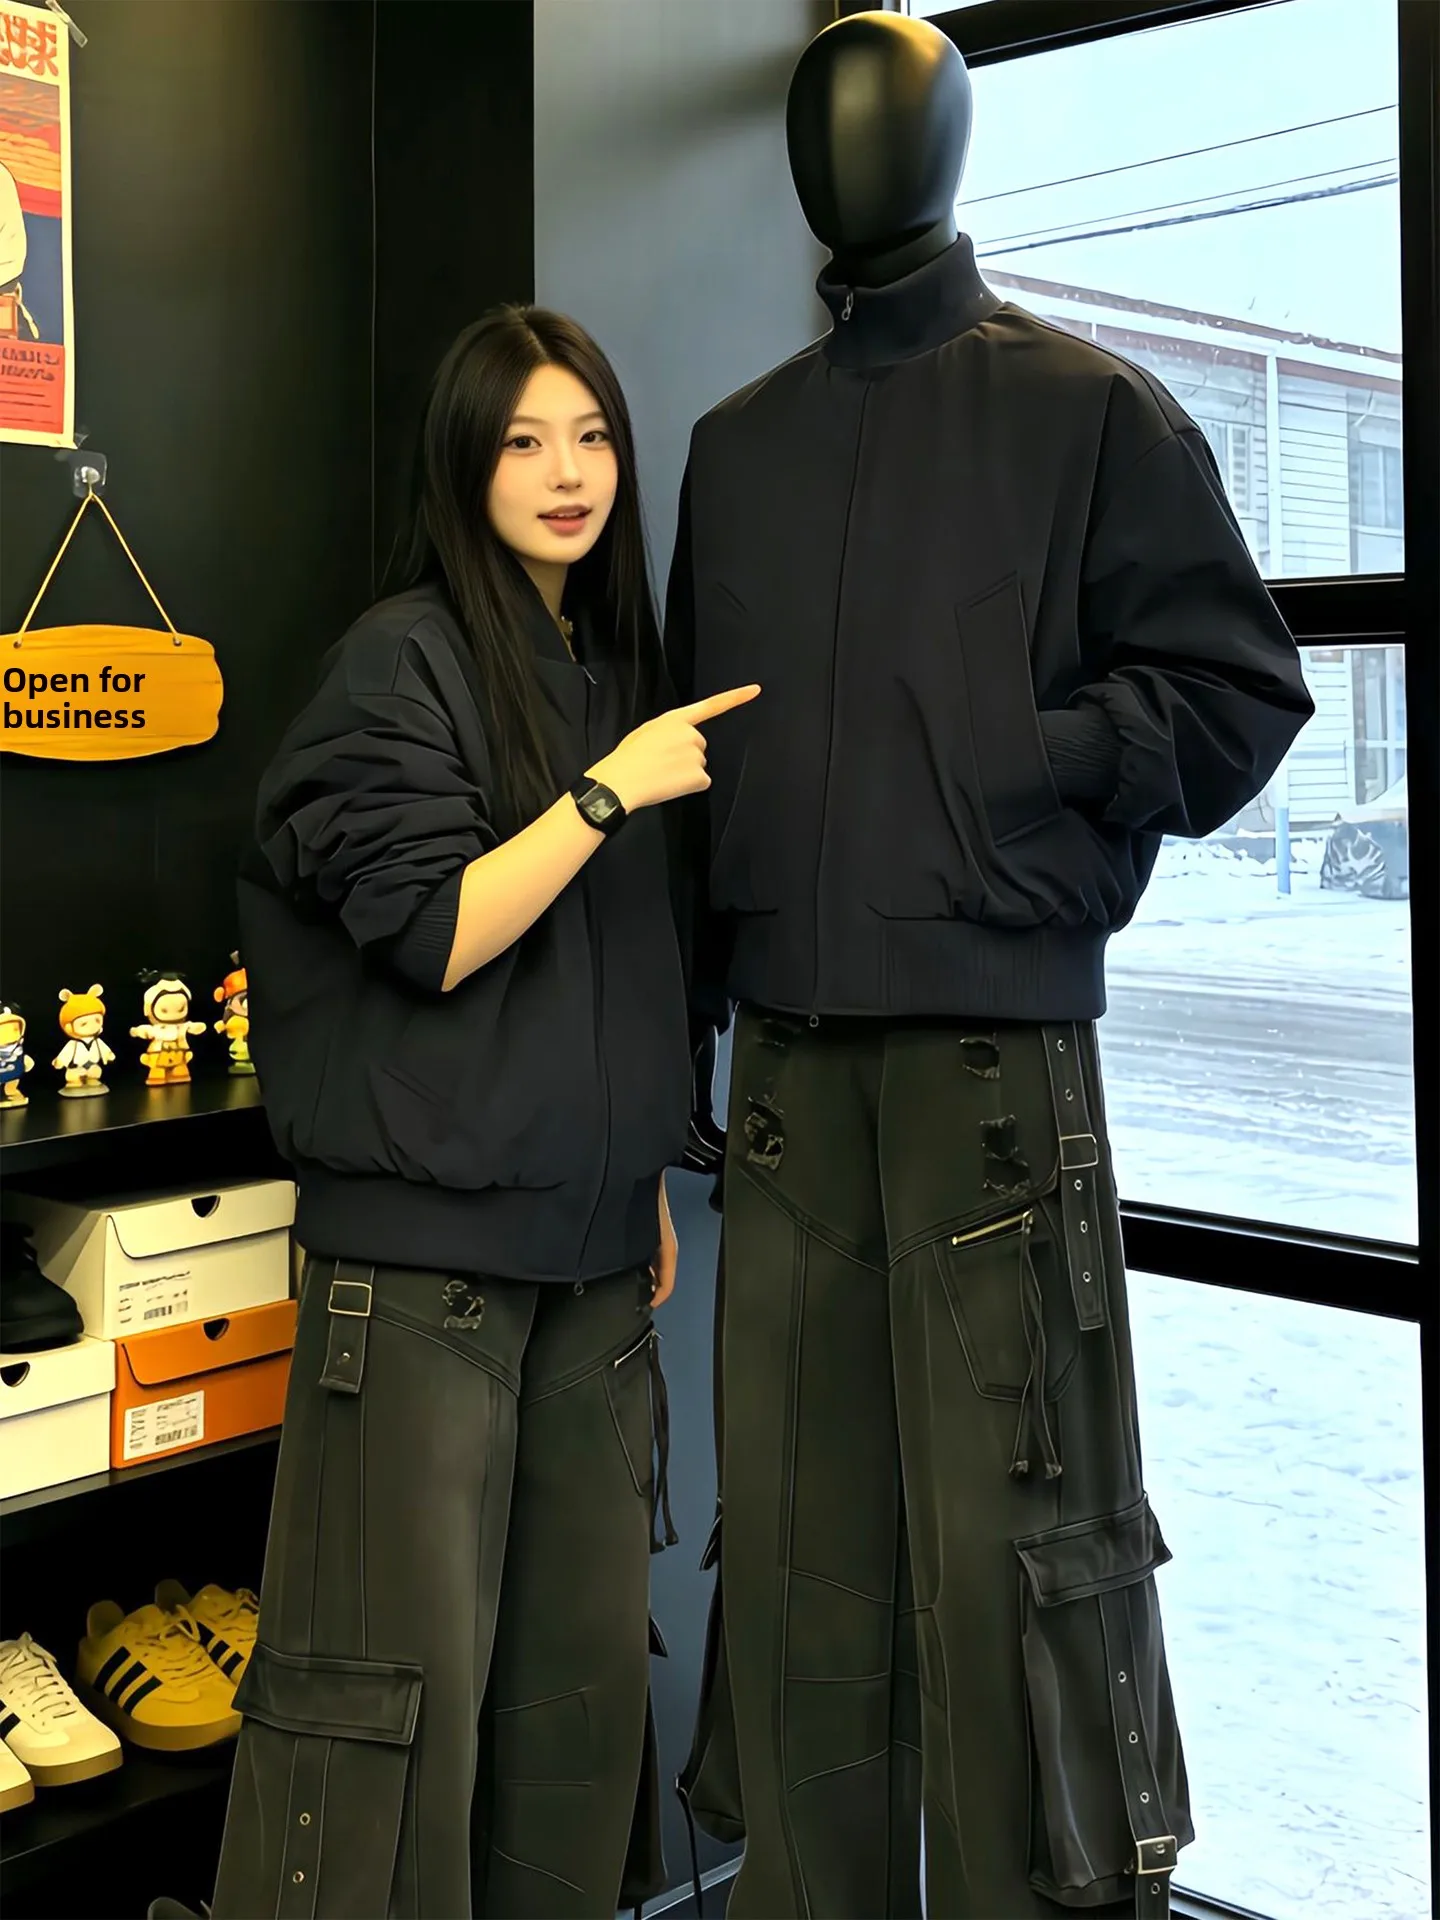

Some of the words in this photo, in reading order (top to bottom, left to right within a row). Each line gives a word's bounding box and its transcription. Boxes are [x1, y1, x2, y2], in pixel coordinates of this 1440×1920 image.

[3, 667, 90, 700] Open
[98, 665, 146, 693] for
[3, 701, 146, 729] business
